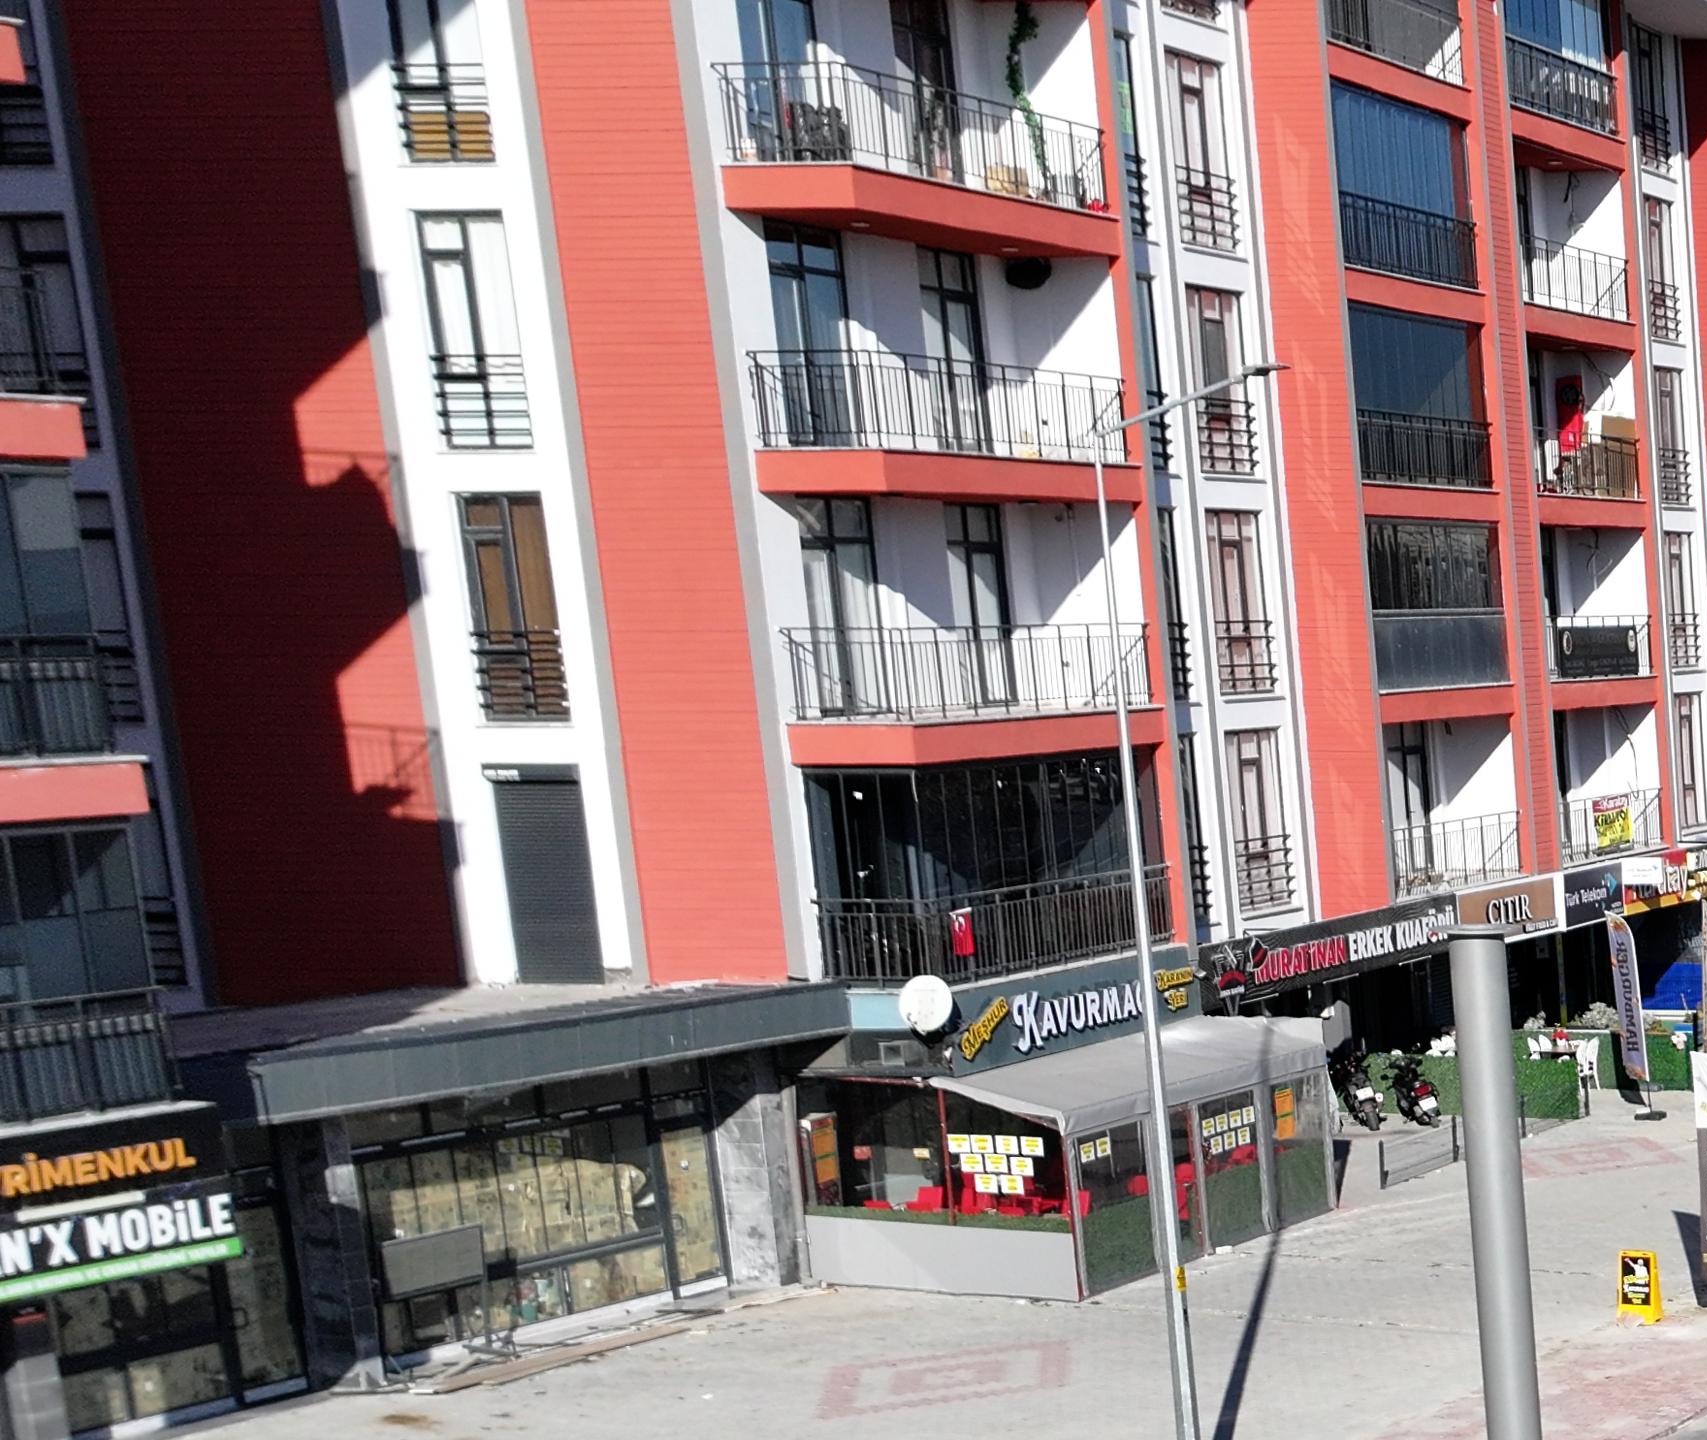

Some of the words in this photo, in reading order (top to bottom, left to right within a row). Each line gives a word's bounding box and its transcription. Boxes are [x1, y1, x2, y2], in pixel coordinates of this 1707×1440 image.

[1565, 890, 1581, 908] Türk
[1580, 886, 1608, 904] Telekom
[1348, 924, 1395, 963] ERKEK
[960, 996, 1009, 1062] MEŞHUR
[1012, 981, 1144, 1054] KAVURMAC
[0, 1137, 197, 1198] RİMENKUL
[0, 1220, 79, 1277] N'X
